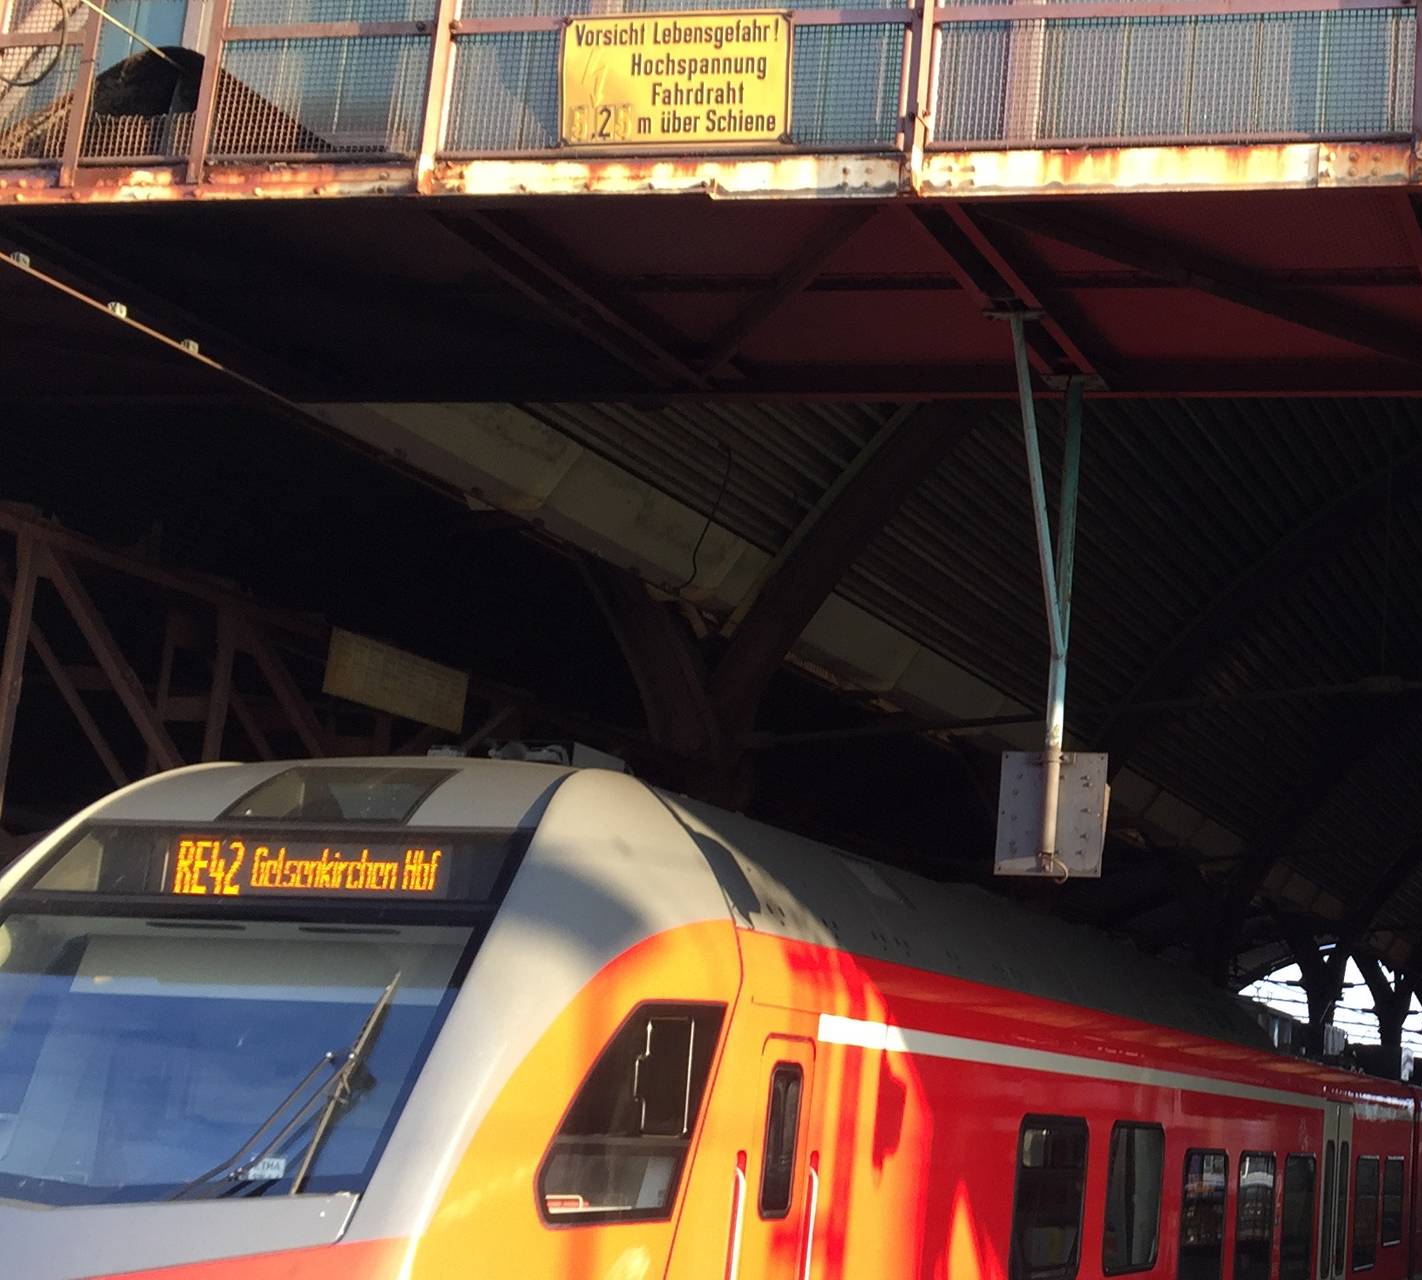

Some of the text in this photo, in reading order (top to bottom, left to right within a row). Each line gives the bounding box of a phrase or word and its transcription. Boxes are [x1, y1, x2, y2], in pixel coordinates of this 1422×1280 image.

[576, 18, 779, 49] Vorsicht Lebensgefahr!
[631, 53, 767, 80] Hochspannung
[651, 81, 744, 105] Fahrdraht
[638, 117, 651, 134] m
[661, 110, 701, 134] über
[706, 108, 776, 133] Schiene
[173, 840, 441, 896] RE42 Gelsenkirchen Hbf
